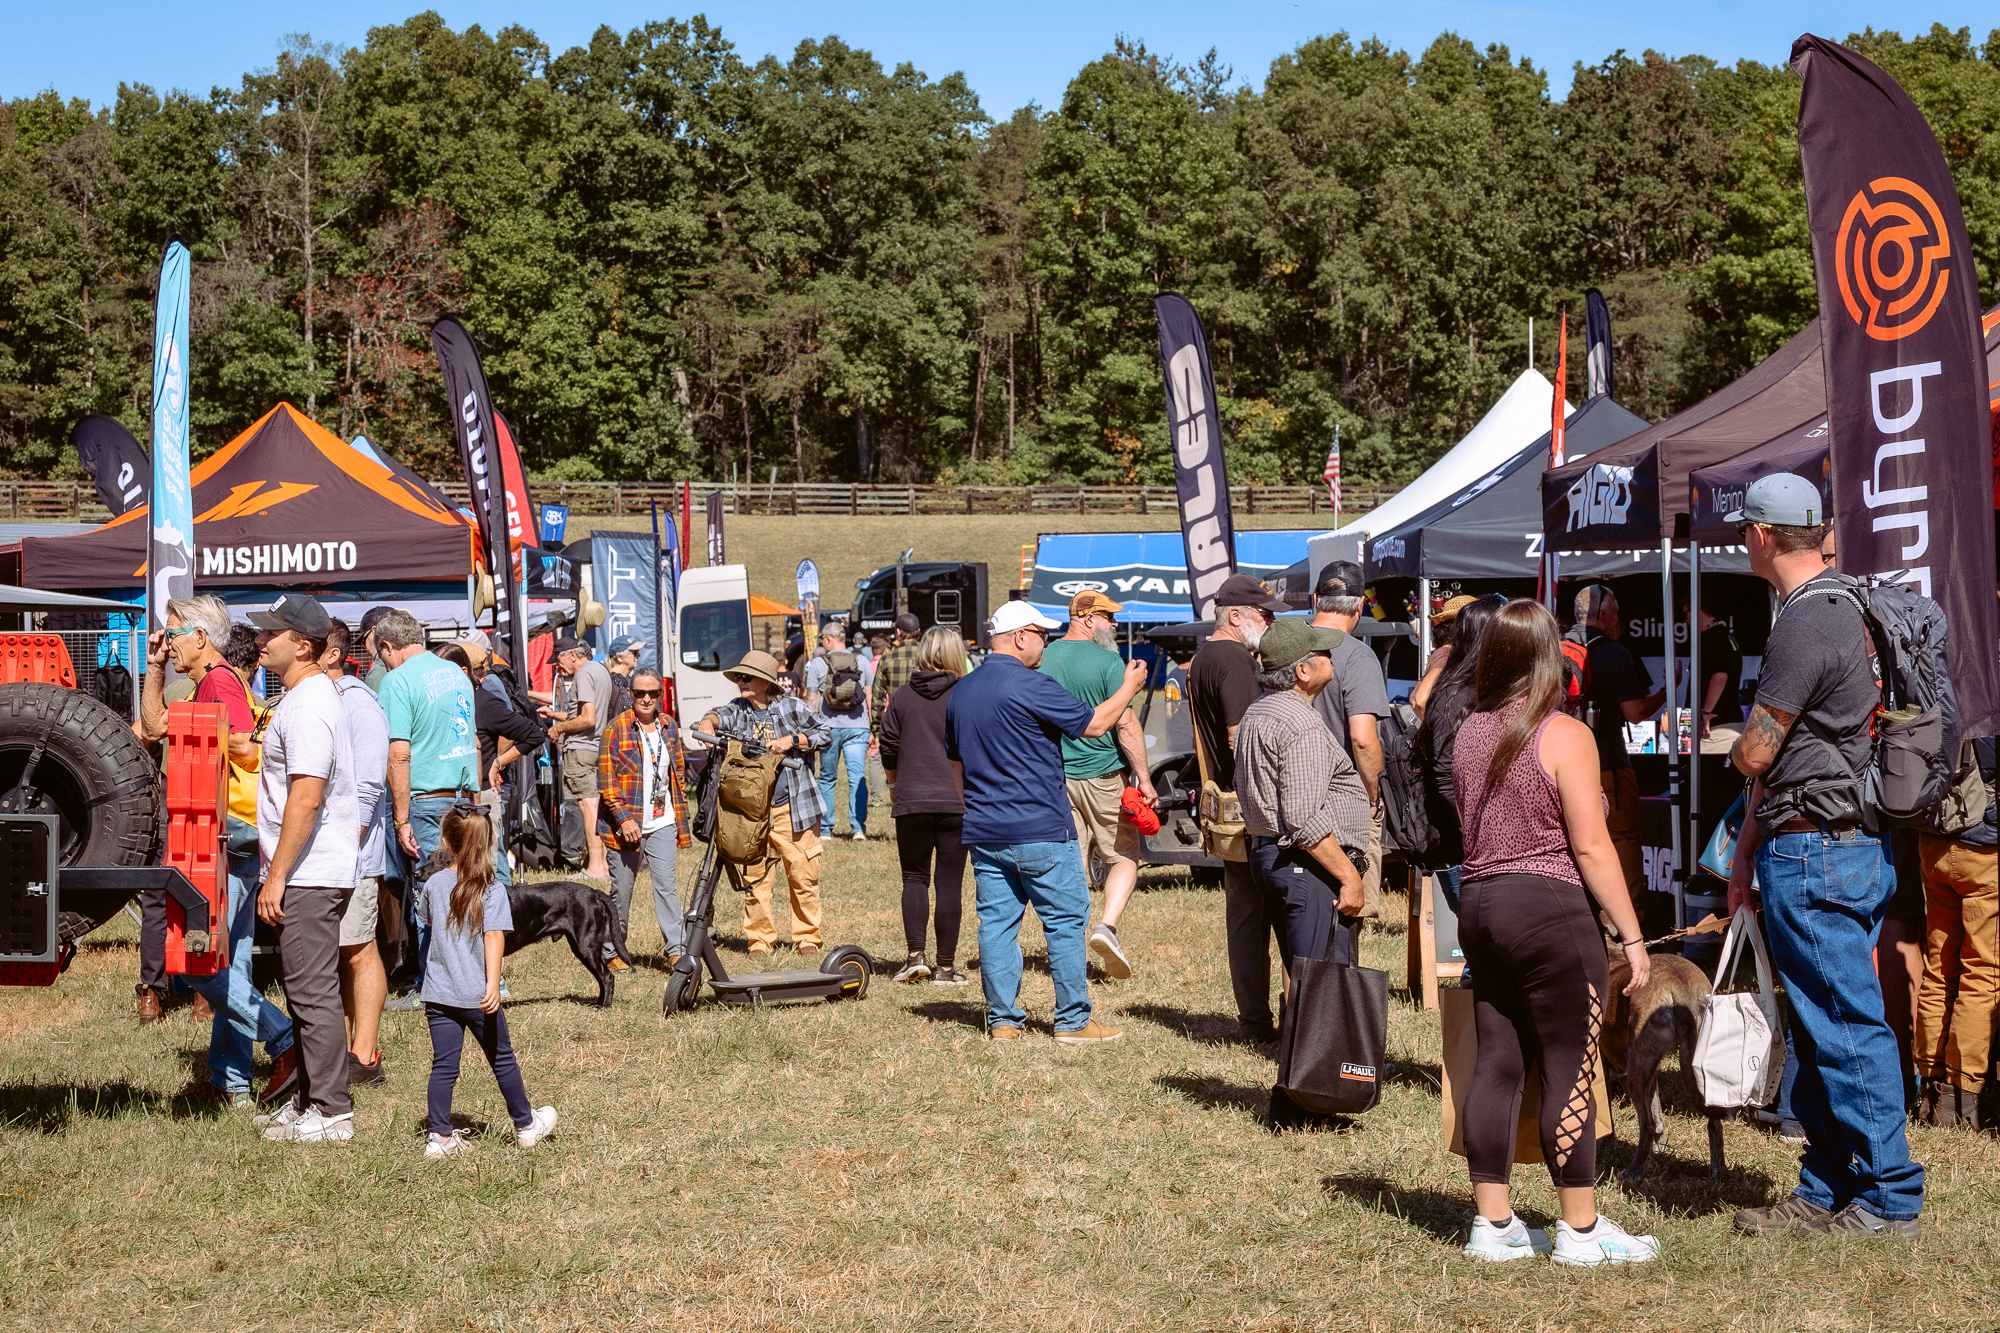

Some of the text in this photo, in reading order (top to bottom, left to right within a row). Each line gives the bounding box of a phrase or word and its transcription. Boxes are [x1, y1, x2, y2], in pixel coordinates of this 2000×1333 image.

[1712, 485, 1744, 513] Merino
[202, 540, 357, 575] MISHIMOTO
[1342, 1064, 1374, 1077] U-HAUL
[1600, 1240, 1628, 1254] HOKA
